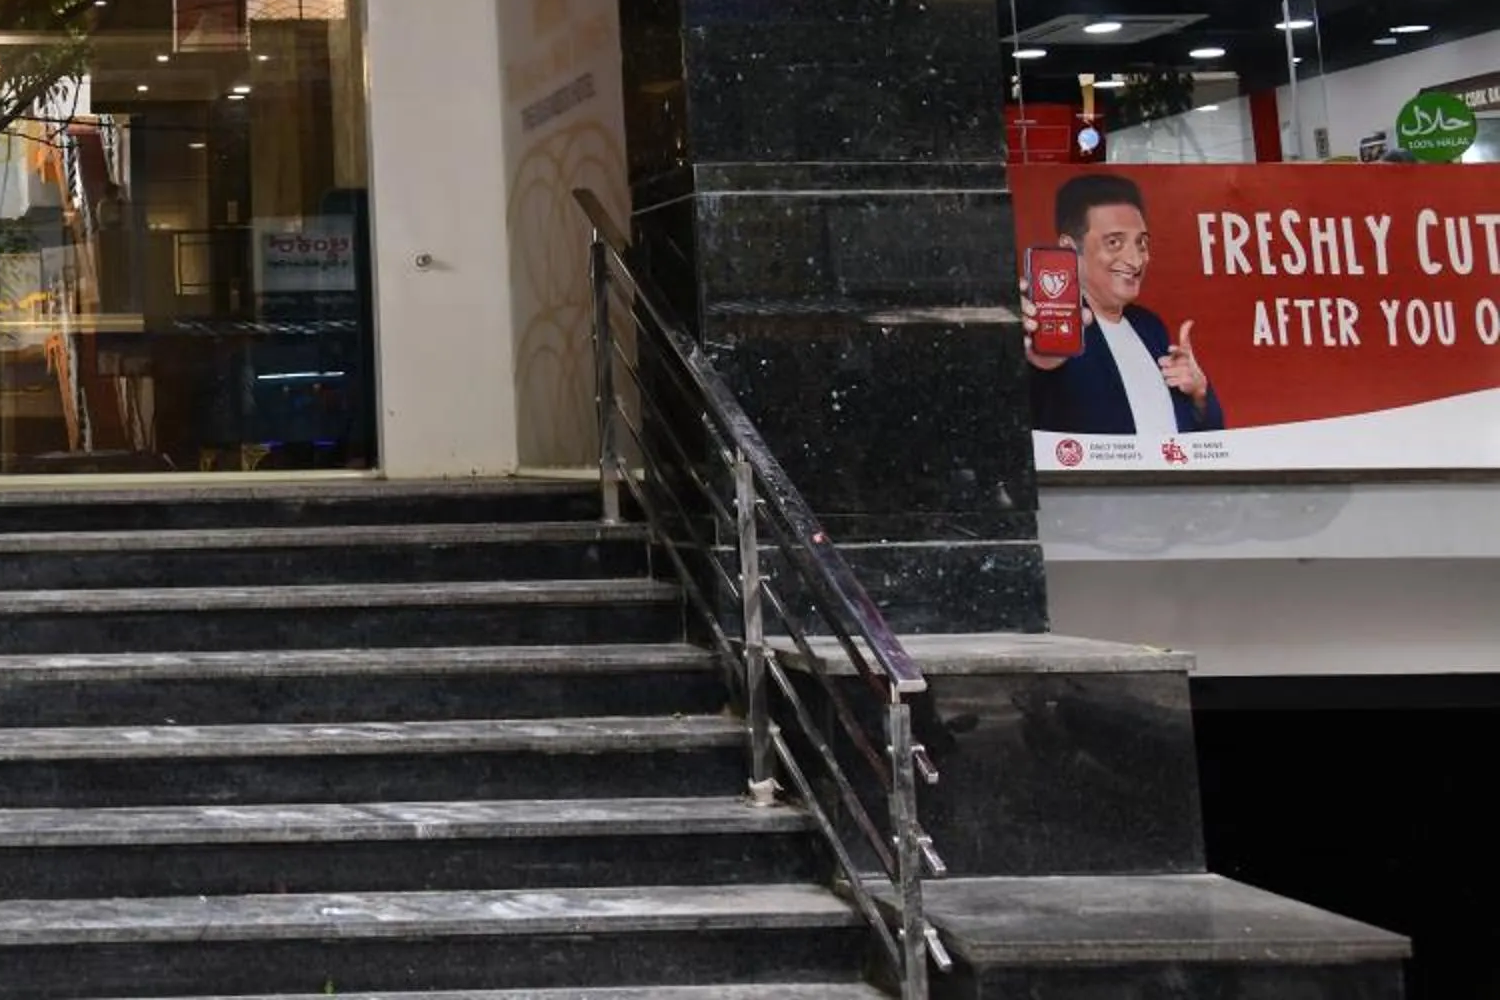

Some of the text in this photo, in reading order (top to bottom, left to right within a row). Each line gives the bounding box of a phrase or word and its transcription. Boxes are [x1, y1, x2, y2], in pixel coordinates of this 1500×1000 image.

[1401, 105, 1472, 137] حلال
[1197, 207, 1500, 276] FRESHLY CUT
[1253, 297, 1362, 346] AFTER
[1379, 299, 1457, 347] YOU
